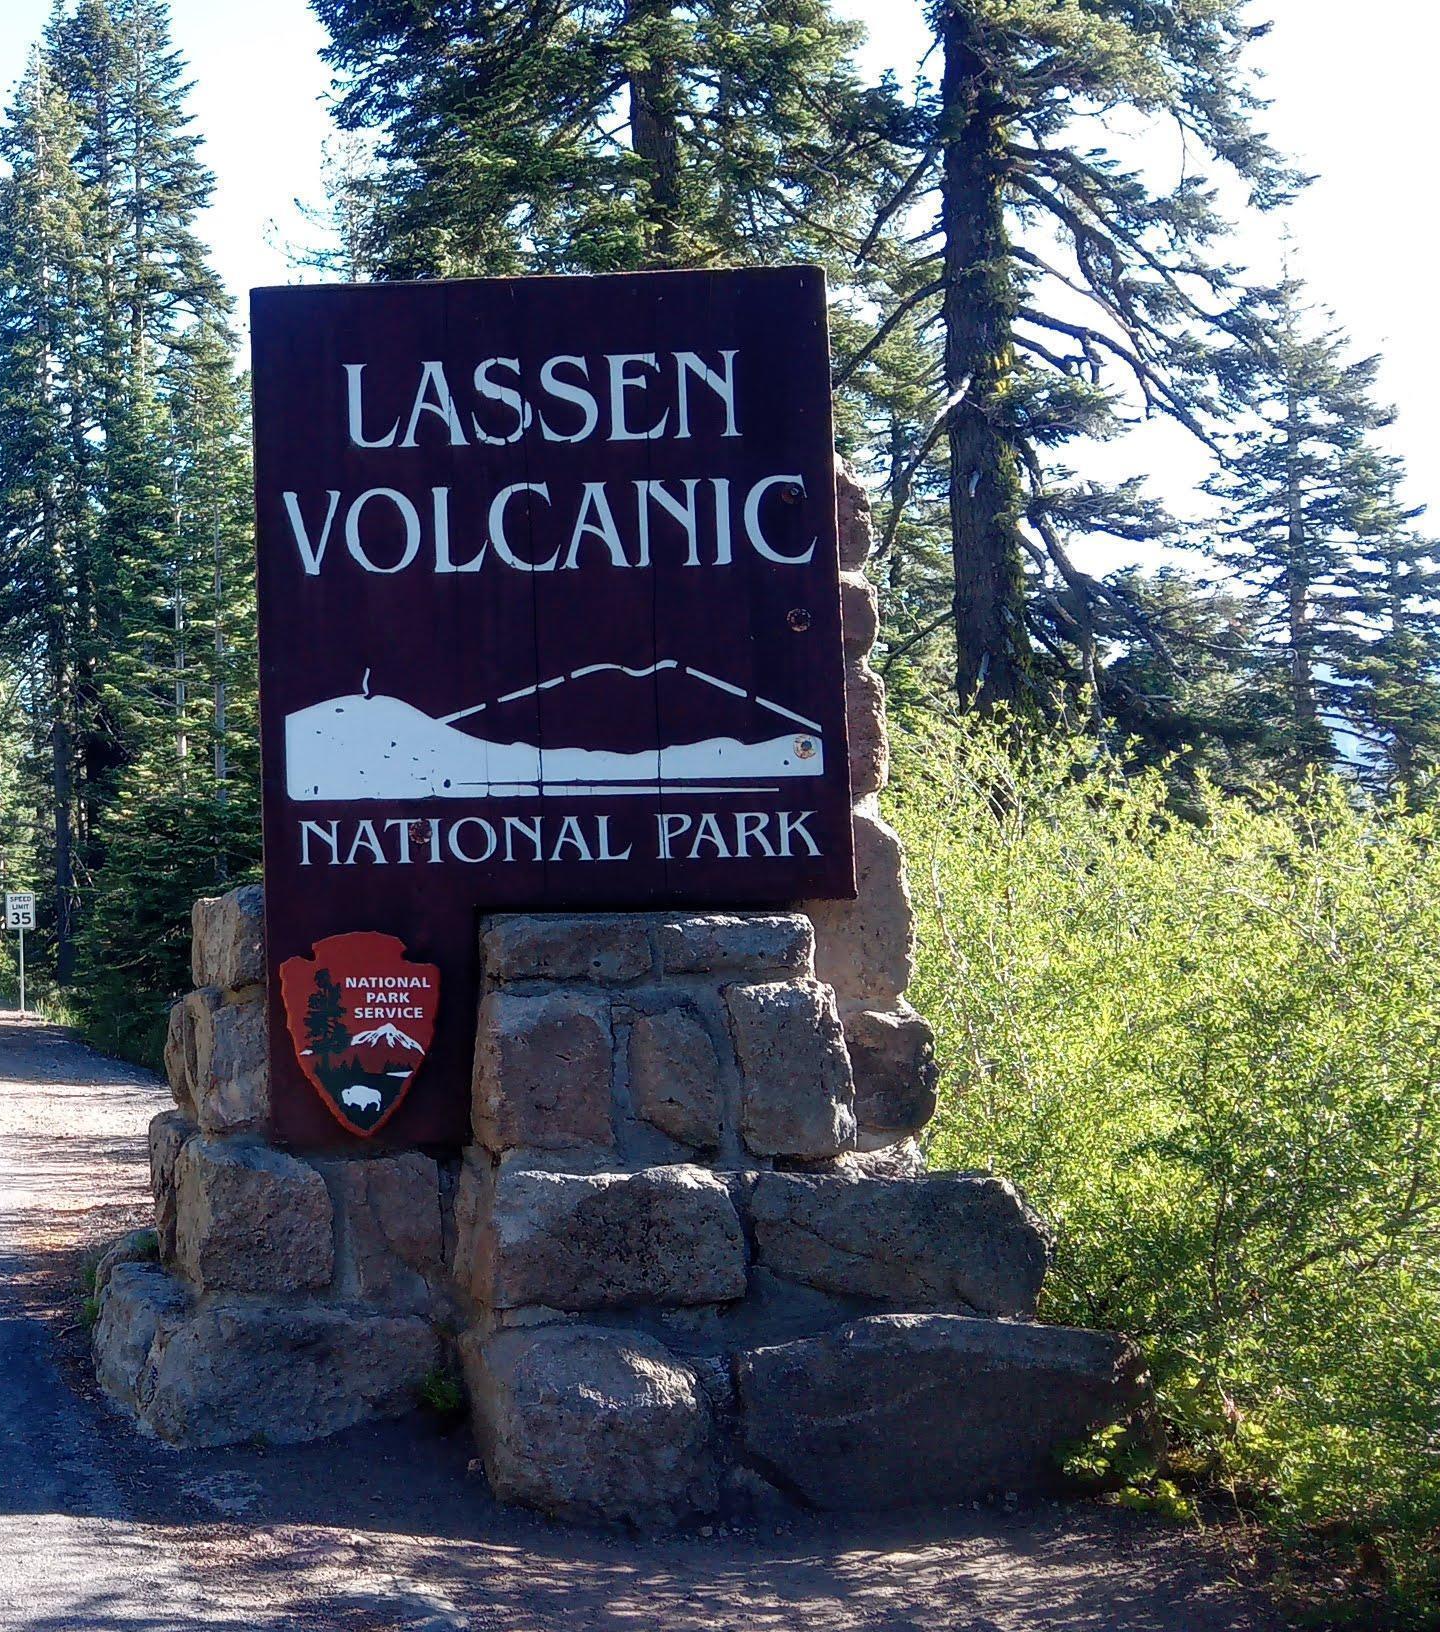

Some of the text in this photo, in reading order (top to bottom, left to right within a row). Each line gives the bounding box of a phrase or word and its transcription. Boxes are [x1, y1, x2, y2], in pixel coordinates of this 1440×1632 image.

[342, 350, 743, 448] LASSEN
[282, 474, 818, 576] VOLCANIC
[298, 810, 824, 866] NATIONAL PARK
[11, 912, 31, 925] 35
[345, 977, 430, 988] NATIONAL
[366, 992, 409, 1003] PARK
[354, 1007, 423, 1019] SERVICE
